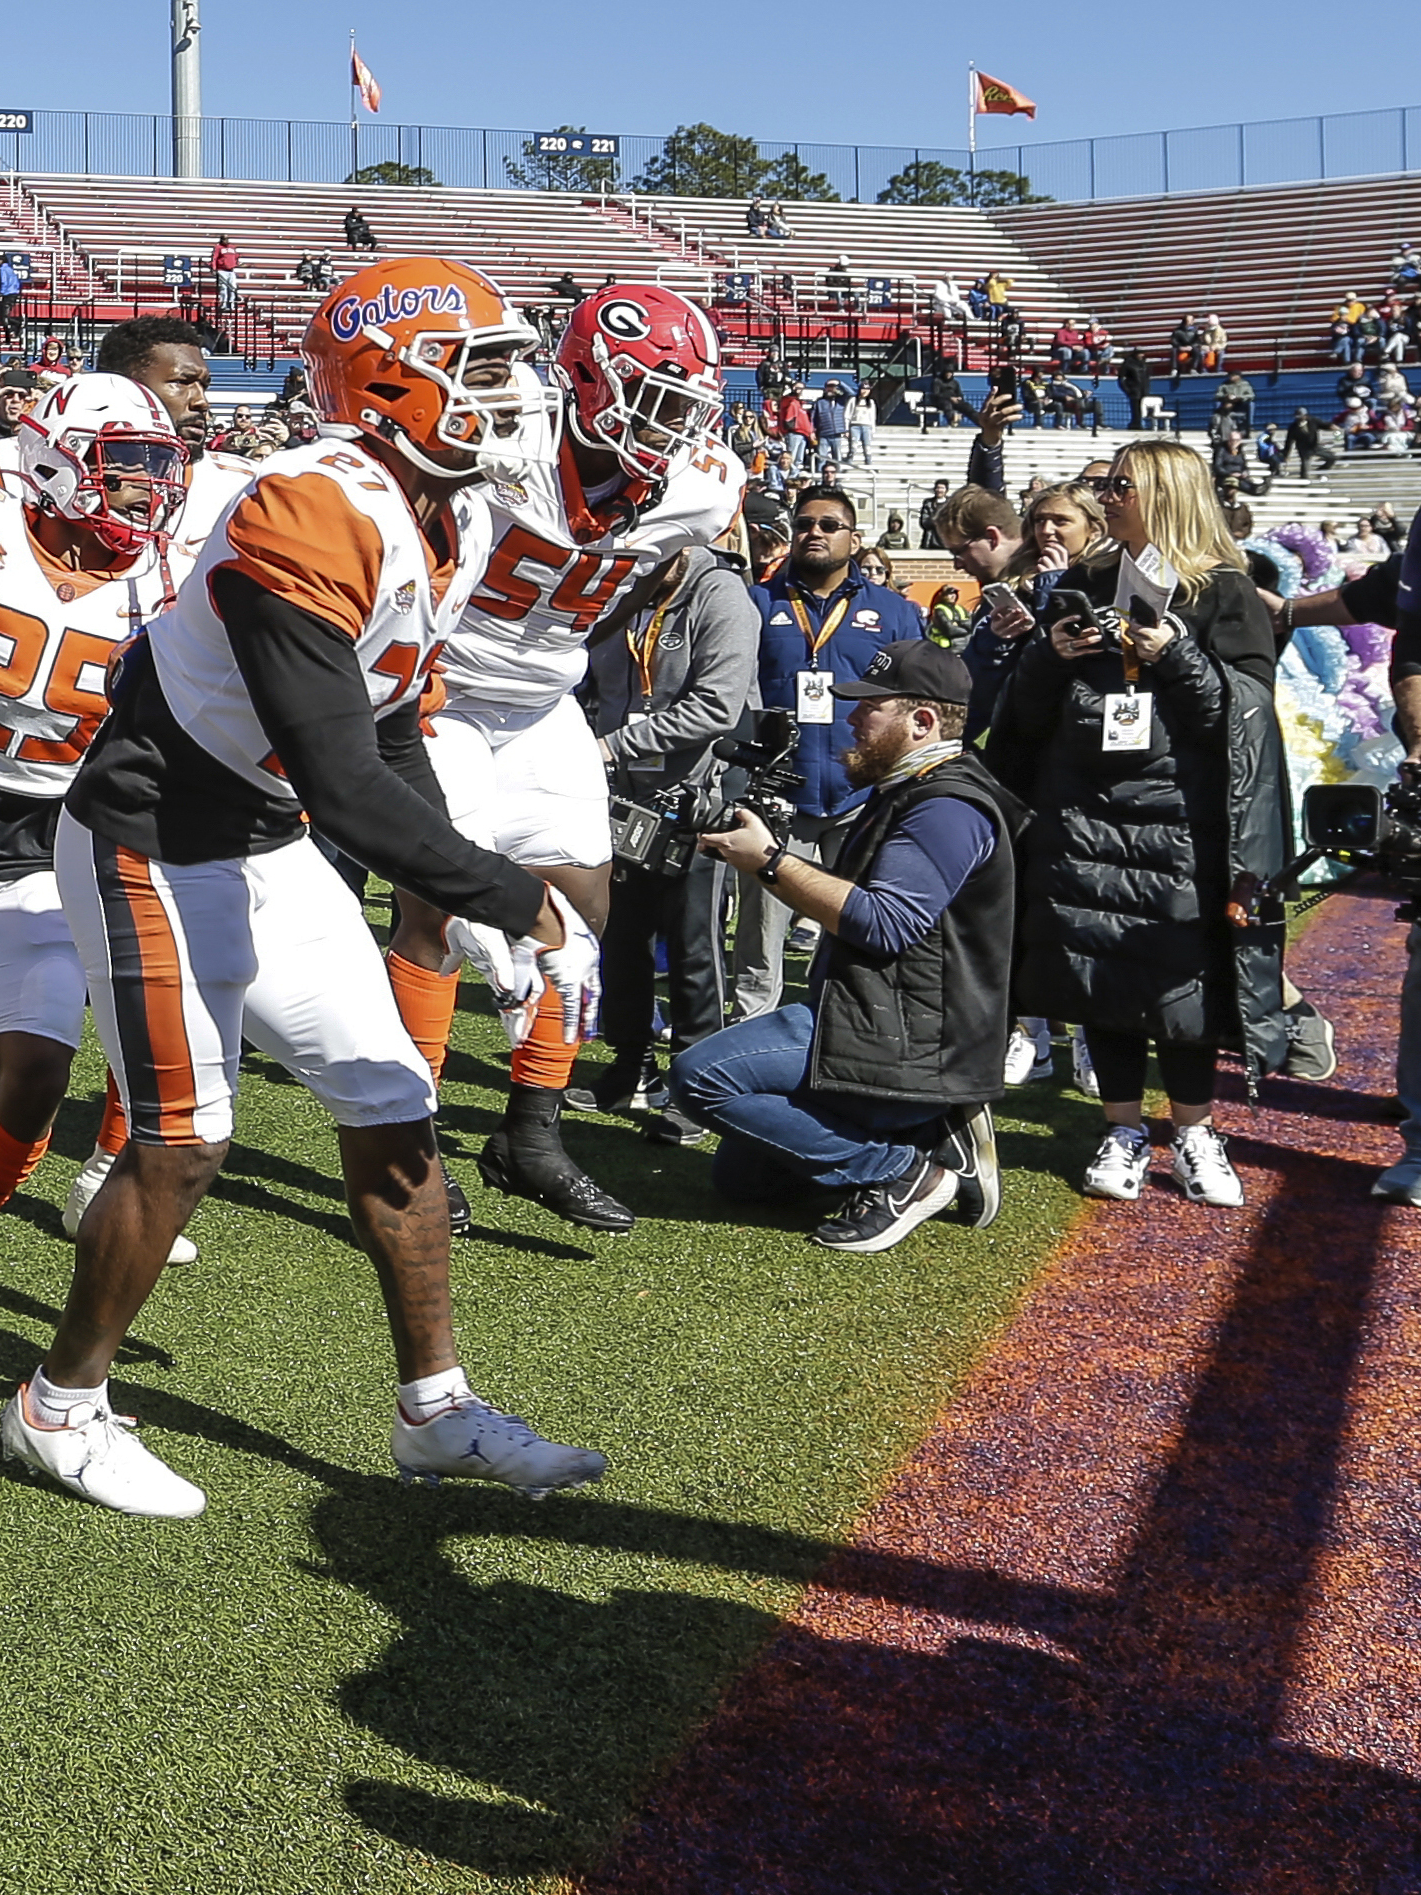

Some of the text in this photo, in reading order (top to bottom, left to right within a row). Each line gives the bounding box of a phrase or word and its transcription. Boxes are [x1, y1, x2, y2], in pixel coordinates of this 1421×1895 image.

[539, 136, 615, 153] 220 221
[330, 283, 469, 342] Gators
[42, 383, 79, 420] N
[469, 522, 640, 633] 54
